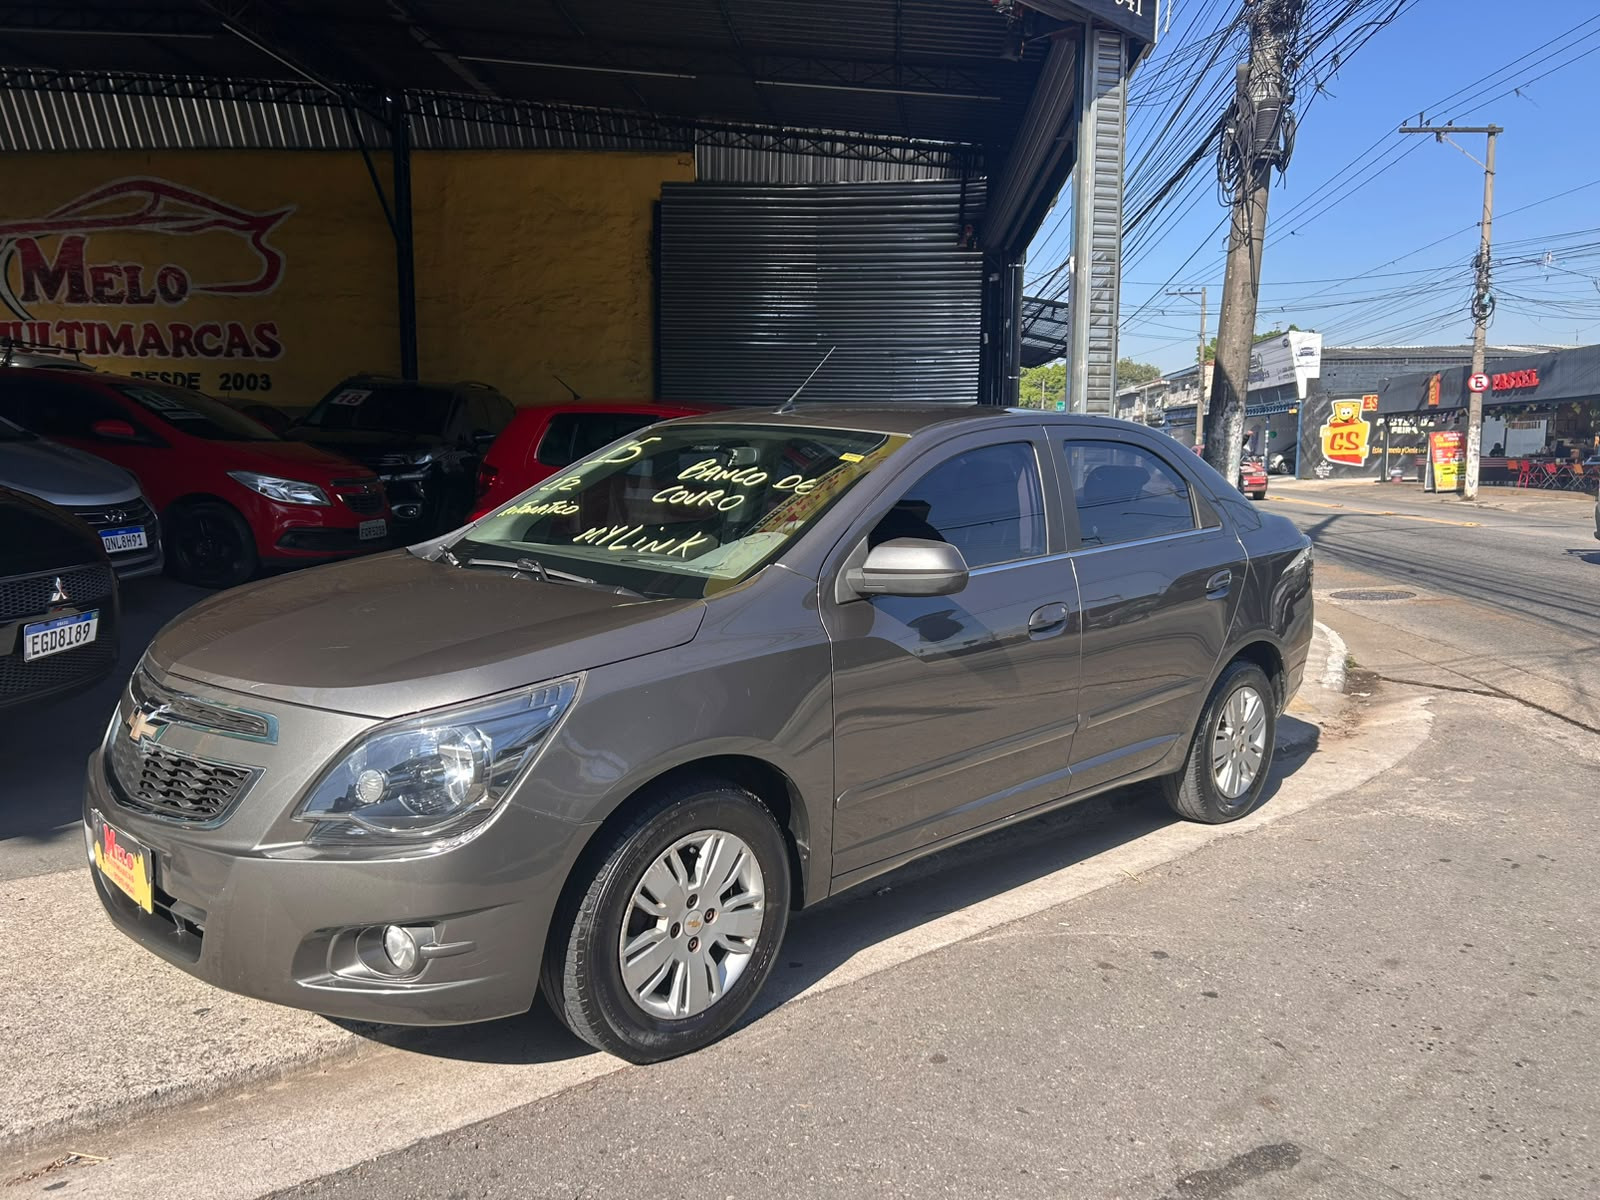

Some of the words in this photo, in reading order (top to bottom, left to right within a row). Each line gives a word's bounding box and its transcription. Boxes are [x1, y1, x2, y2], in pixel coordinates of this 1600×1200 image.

[219, 372, 272, 391] 2003
[1475, 376, 1484, 388] E
[1330, 431, 1360, 451] GS
[677, 458, 768, 486] BANCO
[772, 474, 817, 495] DE
[651, 485, 745, 511] COURO
